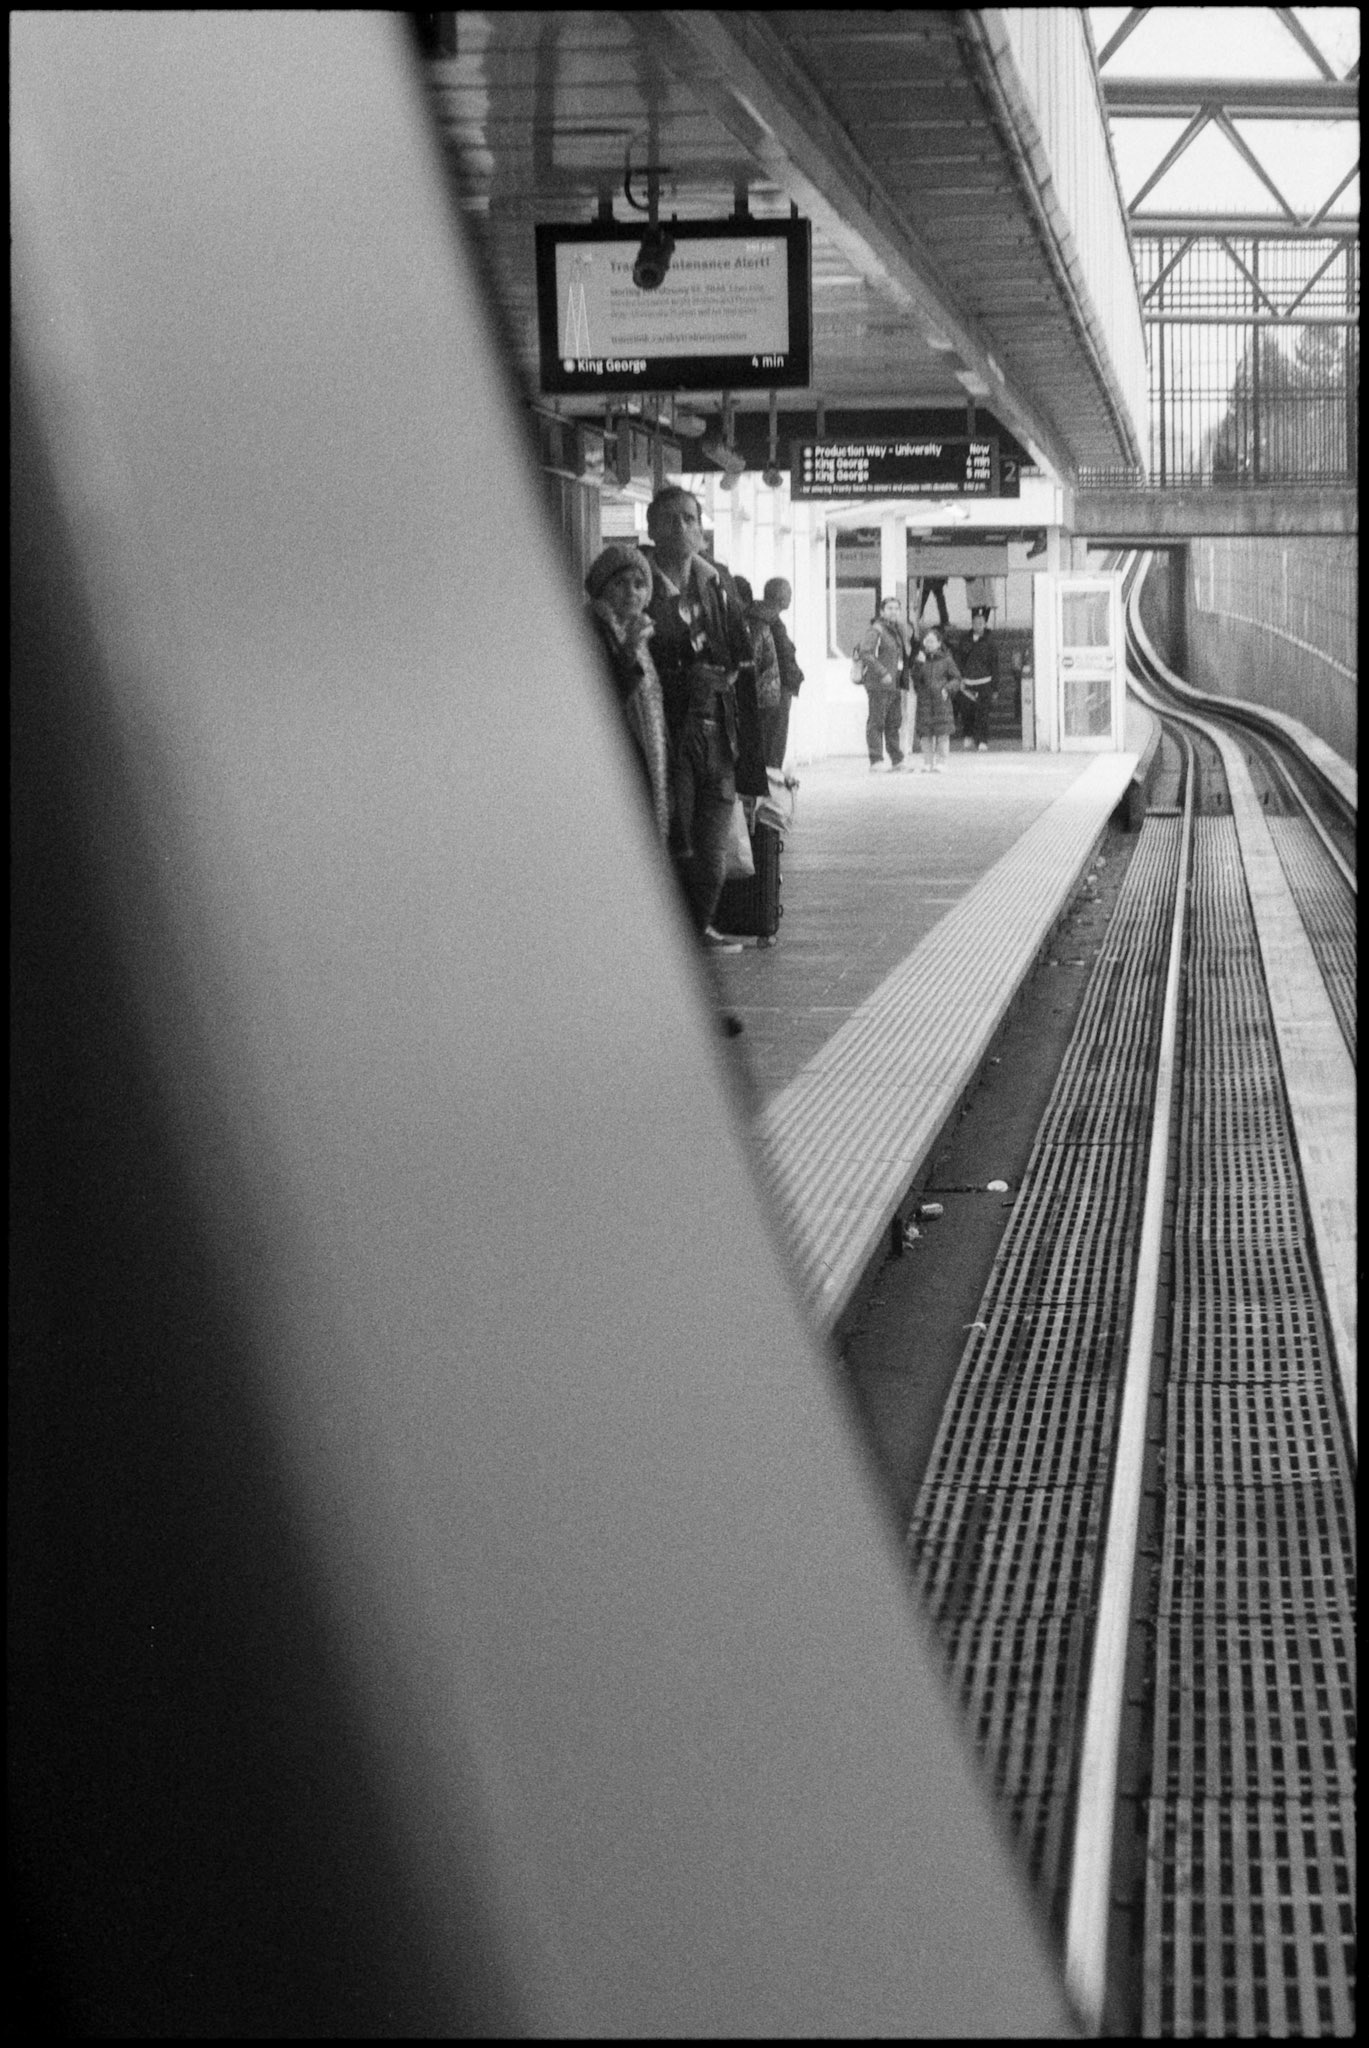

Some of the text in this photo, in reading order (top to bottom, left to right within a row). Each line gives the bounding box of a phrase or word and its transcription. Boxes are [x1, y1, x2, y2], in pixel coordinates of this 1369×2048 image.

[578, 359, 647, 376] King George
[762, 352, 785, 368] min
[815, 445, 864, 458] Production
[866, 444, 886, 459] Way
[895, 443, 942, 458] University
[969, 443, 990, 455] Now
[815, 457, 869, 472] King George
[974, 455, 991, 467] min
[815, 470, 869, 484] King George
[974, 467, 991, 479] min
[1004, 460, 1017, 482] 2
